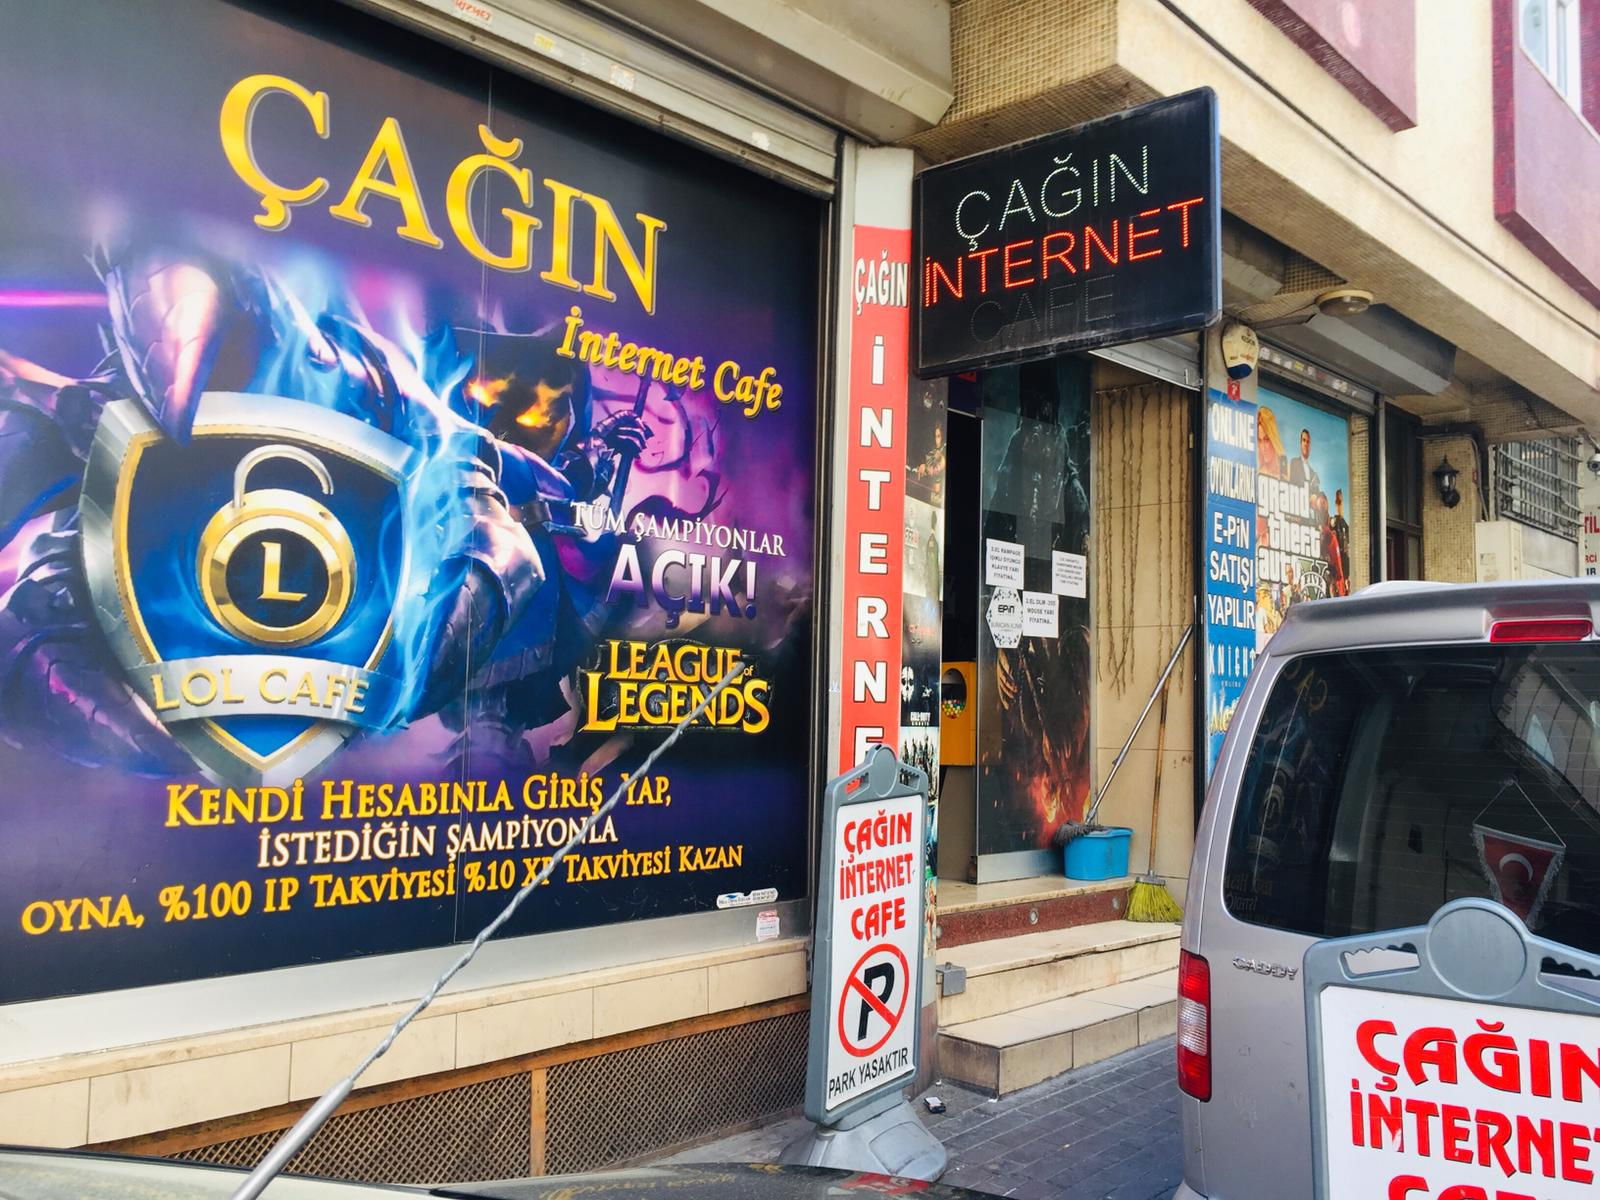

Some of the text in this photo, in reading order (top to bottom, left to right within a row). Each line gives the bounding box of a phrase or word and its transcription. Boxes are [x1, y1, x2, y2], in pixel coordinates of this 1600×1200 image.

[219, 74, 667, 314] ÇAĞIN
[955, 145, 1149, 251] ÇAĞIN
[924, 197, 1204, 307] İNTERNET
[854, 249, 909, 316] ÇAĞIN
[970, 274, 1116, 343] CAFE
[556, 306, 784, 417] İnternet Cafe
[1212, 403, 1254, 452] ONLINE
[1258, 474, 1310, 519] grand
[571, 501, 786, 557] TÜM ŞAMPİYONLAR
[1268, 512, 1321, 559] theft
[605, 543, 757, 629] AÇIK!
[1210, 550, 1254, 593] SATIŞI
[1208, 594, 1255, 630] YAPILIR
[605, 640, 754, 685] LEAGUE of
[150, 669, 370, 713] LOL CAFE
[578, 672, 770, 734] LEGENDS
[164, 771, 671, 828] KENDİ HESABINLA GİRİŞ YAP,
[257, 813, 618, 868] İSTEDİĞİN ŞAMPİYONLA
[844, 809, 912, 863] ÇAĞIN
[21, 893, 145, 935] OYNA,
[159, 881, 252, 923] %100
[263, 877, 299, 913] IP
[309, 863, 456, 908] TAKVİYESİ
[463, 861, 516, 893] %10
[562, 845, 672, 883] TAKVİYESİ
[678, 844, 744, 872] KAZAN
[840, 853, 913, 900] İNTERNET
[851, 897, 905, 941] CAFE
[828, 1047, 909, 1100] PARK YASAKTIR
[1356, 1018, 1600, 1103] ÇAĞIN
[1349, 1078, 1600, 1184] İNTERNE
